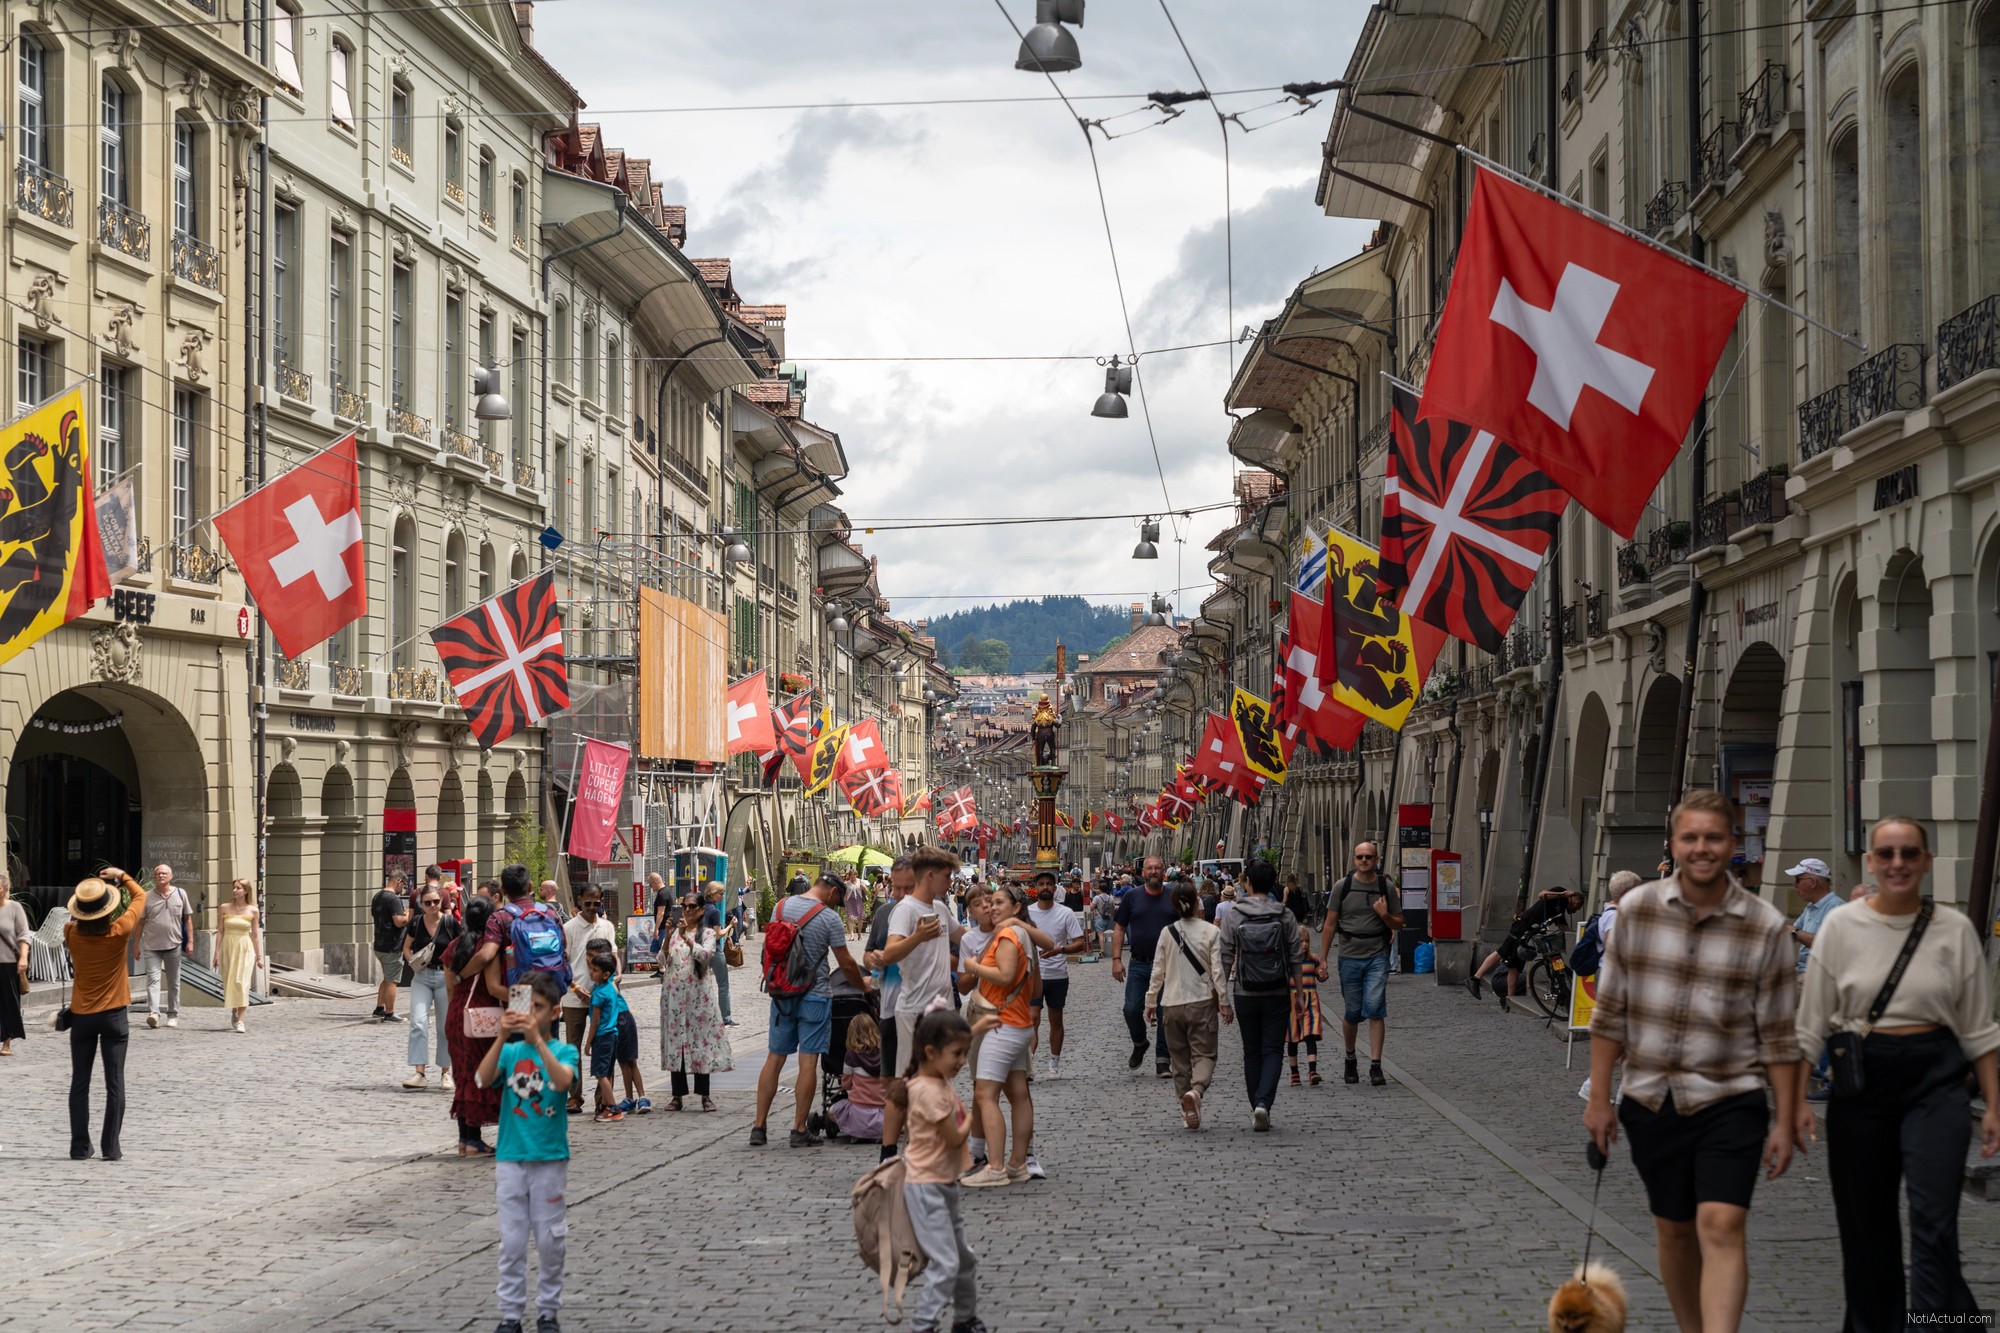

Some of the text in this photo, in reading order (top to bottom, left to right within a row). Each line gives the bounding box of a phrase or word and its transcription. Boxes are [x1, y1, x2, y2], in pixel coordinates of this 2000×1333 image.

[114, 588, 156, 624] BEEF
[190, 608, 206, 623] BAR
[589, 760, 620, 780] LITTLE
[587, 774, 617, 793] COPEN
[584, 787, 615, 806] HAGEN
